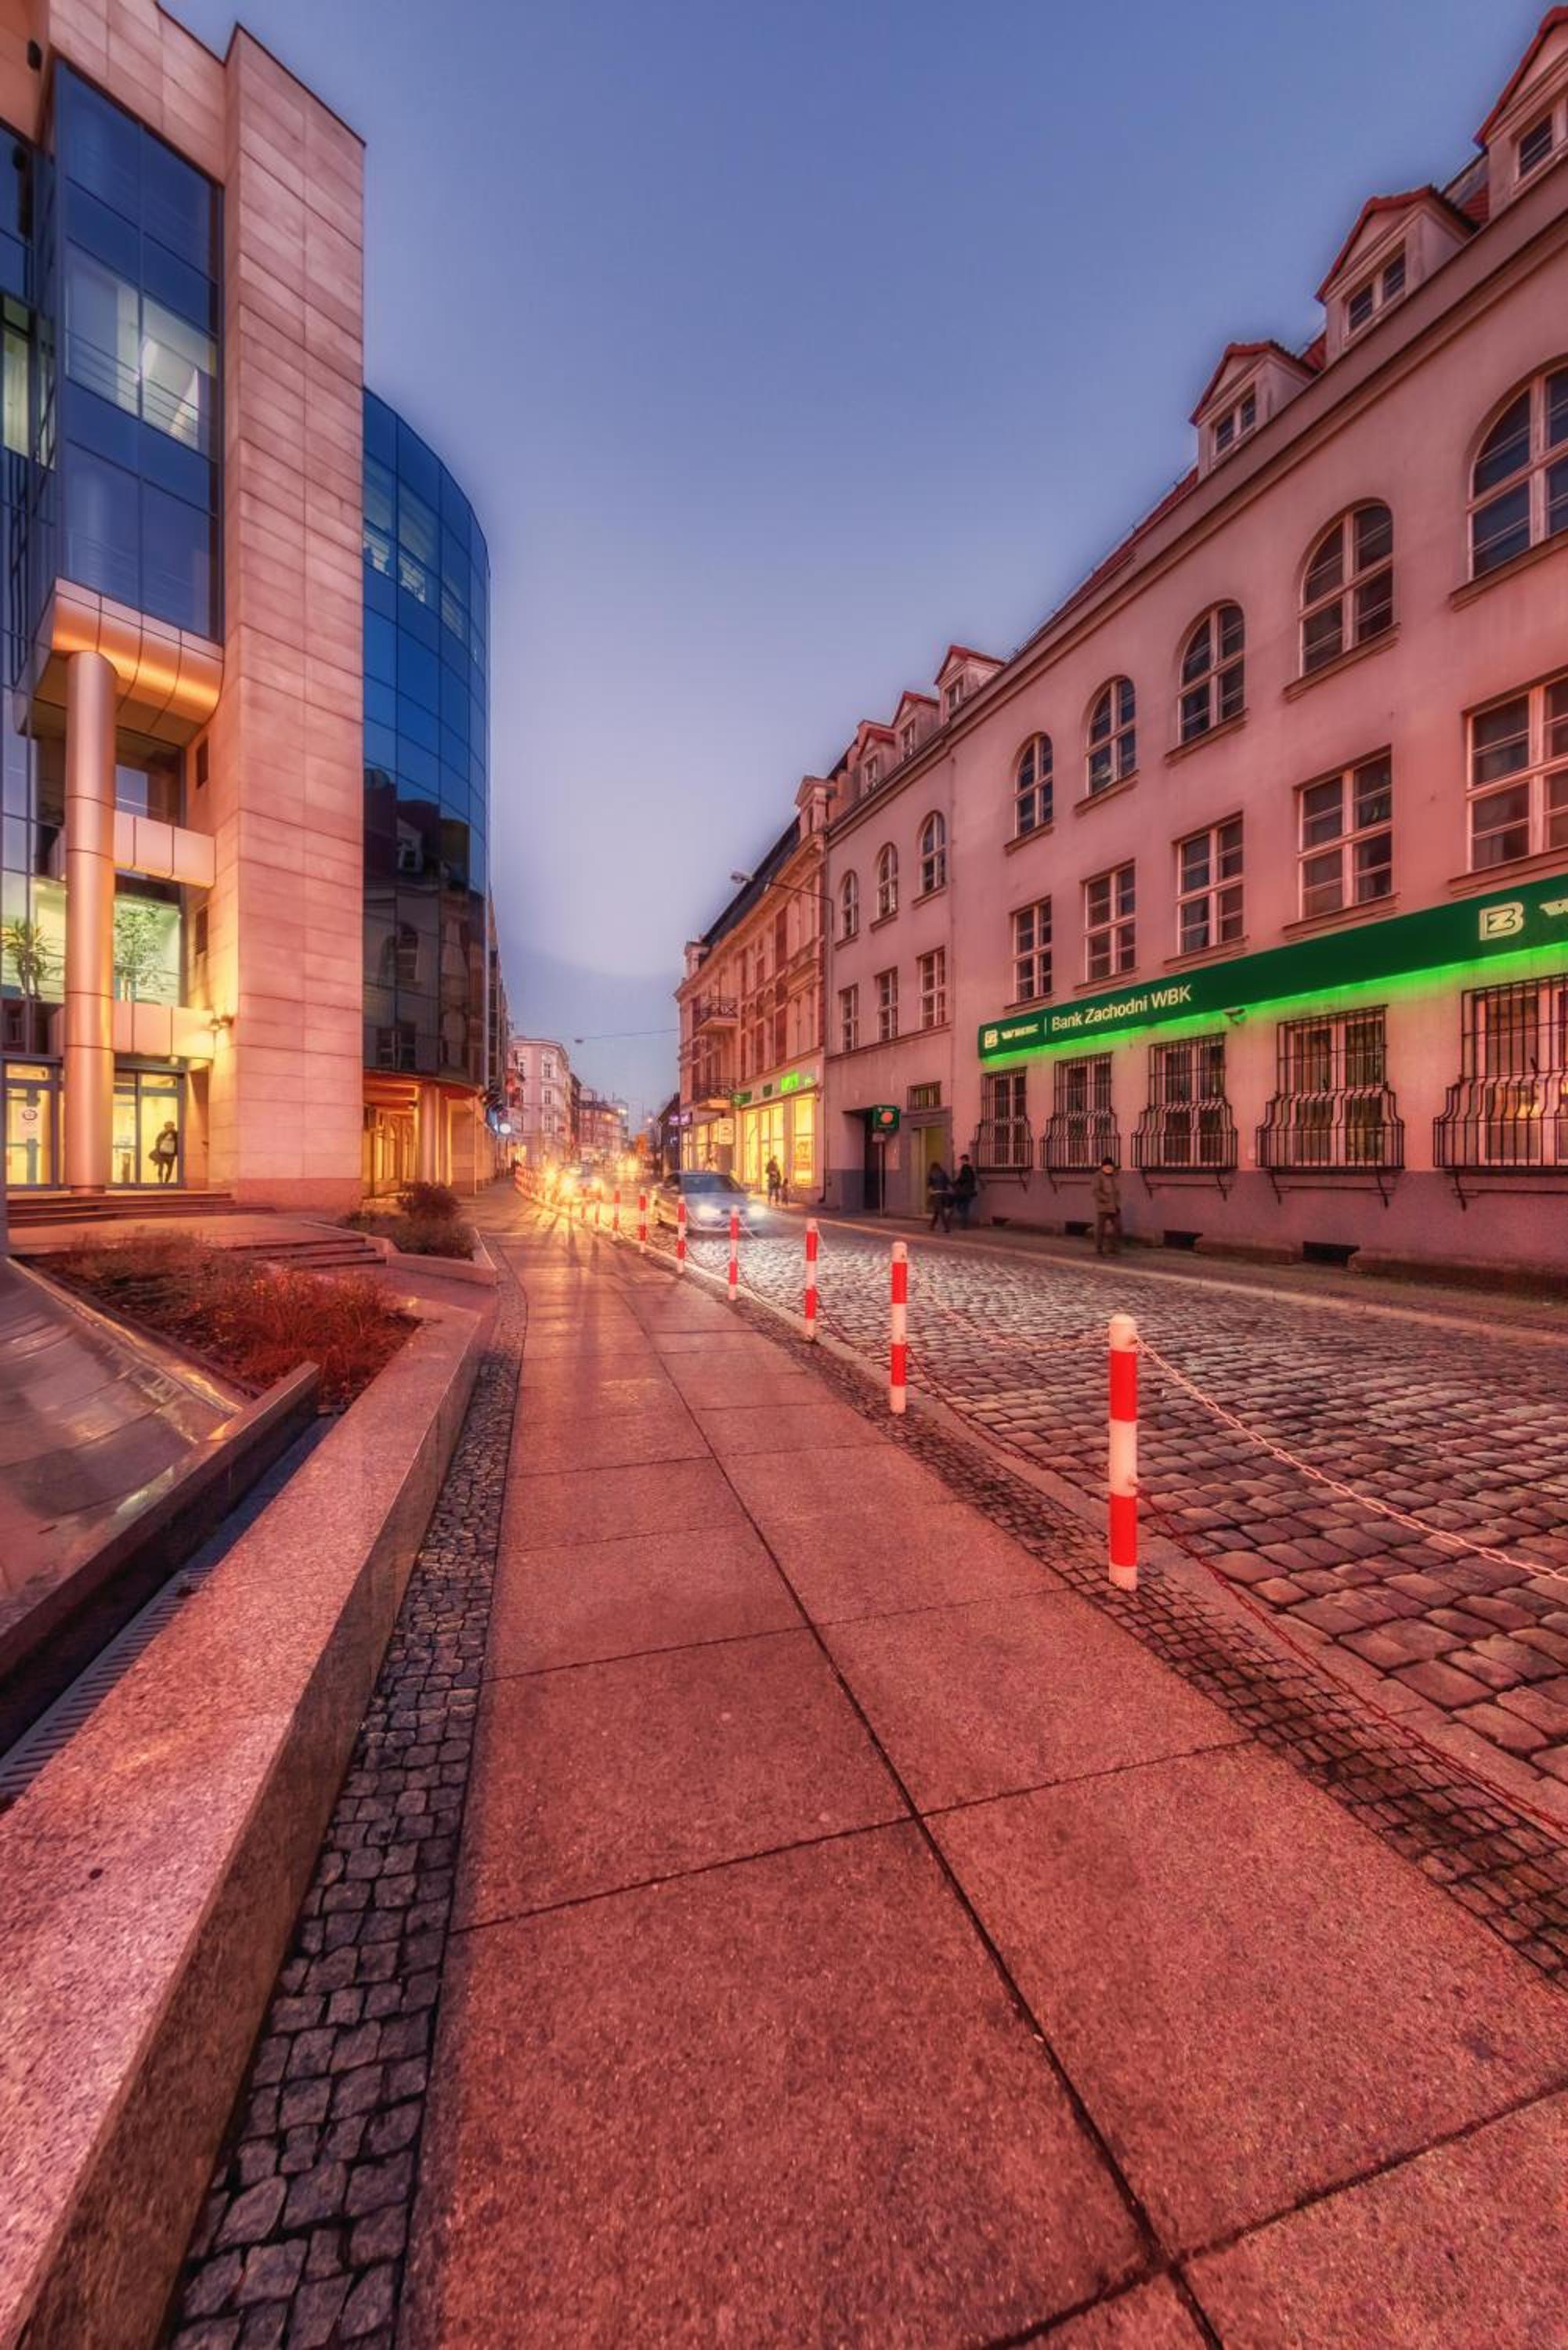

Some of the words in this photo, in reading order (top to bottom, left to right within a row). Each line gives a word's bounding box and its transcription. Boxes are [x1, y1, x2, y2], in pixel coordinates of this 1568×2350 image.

[1051, 1011, 1082, 1032] Bank
[1084, 996, 1148, 1024] Zachodni
[1150, 984, 1192, 1009] WBK
